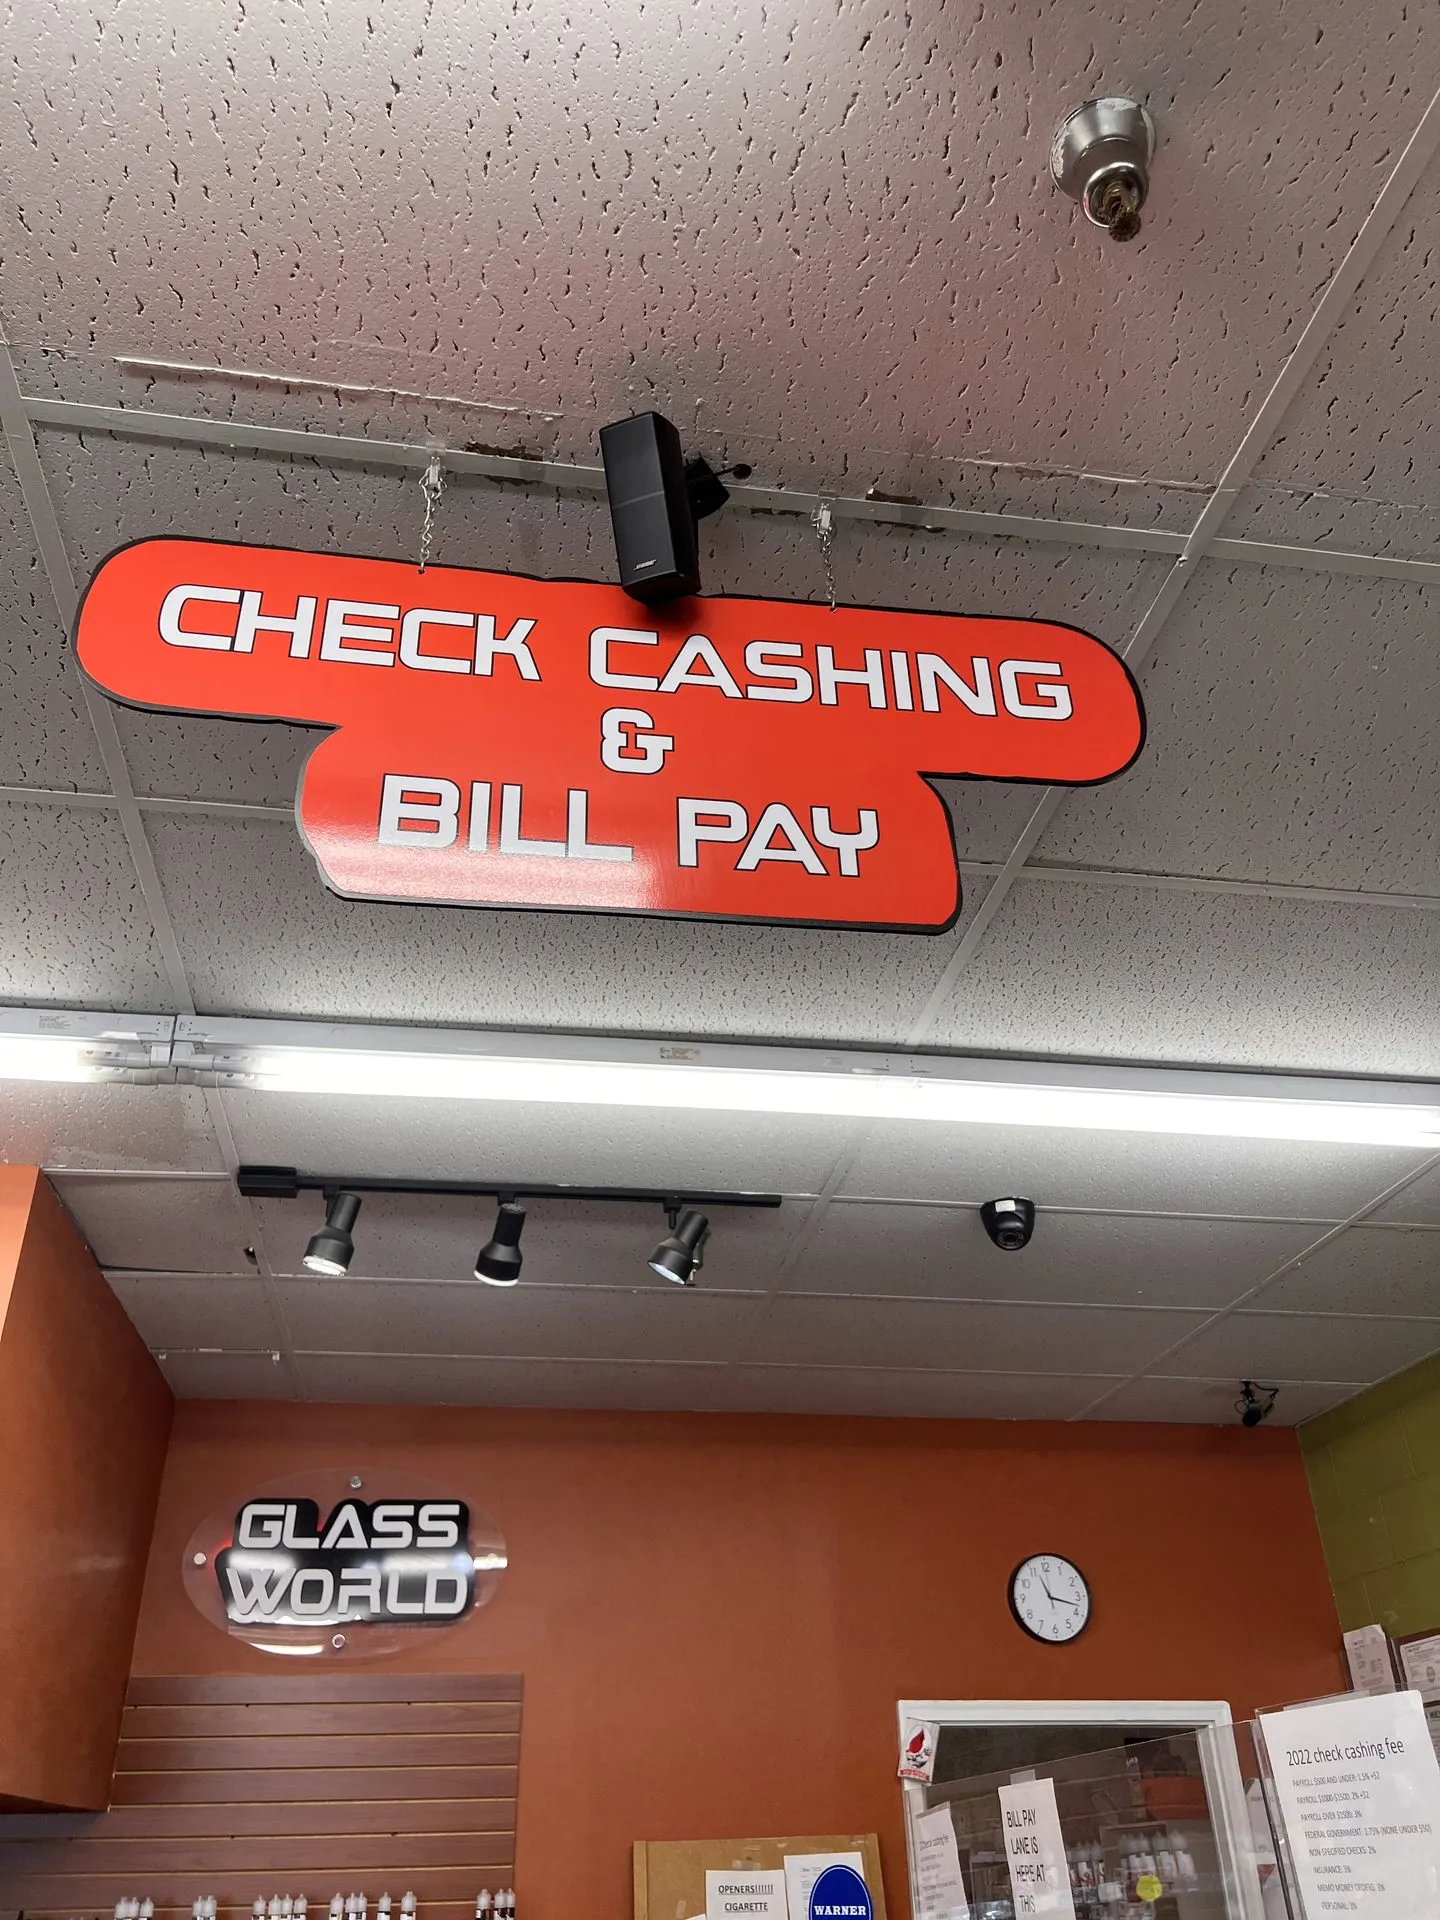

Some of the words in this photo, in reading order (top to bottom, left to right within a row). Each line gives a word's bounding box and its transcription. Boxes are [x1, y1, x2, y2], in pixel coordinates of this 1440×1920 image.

[158, 583, 543, 682] CHECK
[588, 626, 1075, 722] CASHING
[599, 707, 675, 775] &
[377, 773, 634, 863] BILL
[676, 796, 880, 878] PAY
[238, 1503, 461, 1549] GLASS
[1029, 1567, 1037, 1577] 11
[1041, 1562, 1050, 1572] 12
[1058, 1566, 1062, 1576] 1
[1021, 1578, 1030, 1589] 10
[1069, 1577, 1075, 1587] 2
[226, 1567, 468, 1615] WORLD
[1075, 1591, 1080, 1601] 3
[1020, 1593, 1026, 1603] 9
[1026, 1609, 1033, 1619] 8
[1073, 1608, 1079, 1616] 4
[1038, 1620, 1044, 1630] 7
[1052, 1624, 1059, 1634] 6
[1065, 1619, 1072, 1629] 5
[1286, 1749, 1312, 1766] 2022
[1314, 1744, 1343, 1763] check
[1345, 1741, 1385, 1760] cashing
[1385, 1737, 1405, 1754] fee
[1292, 1776, 1314, 1787] PAYROLL
[1327, 1775, 1338, 1784] AND
[1296, 1794, 1318, 1804] PAYROLL
[1007, 1811, 1022, 1827] BILL
[1022, 1808, 1036, 1827] PAY
[1301, 1812, 1322, 1822] PAYROLL
[1322, 1811, 1336, 1821] OVER
[1305, 1830, 1326, 1840] FEDERAL
[1399, 1824, 1419, 1835] UNDER
[1011, 1837, 1030, 1855] LANE
[1031, 1836, 1039, 1854] IS
[1015, 1865, 1035, 1882] HERE
[1036, 1864, 1046, 1882] AT
[724, 1902, 768, 1912] CIGARETTE
[1019, 1895, 1036, 1913] THIS
[814, 1905, 866, 1916] WARNER
